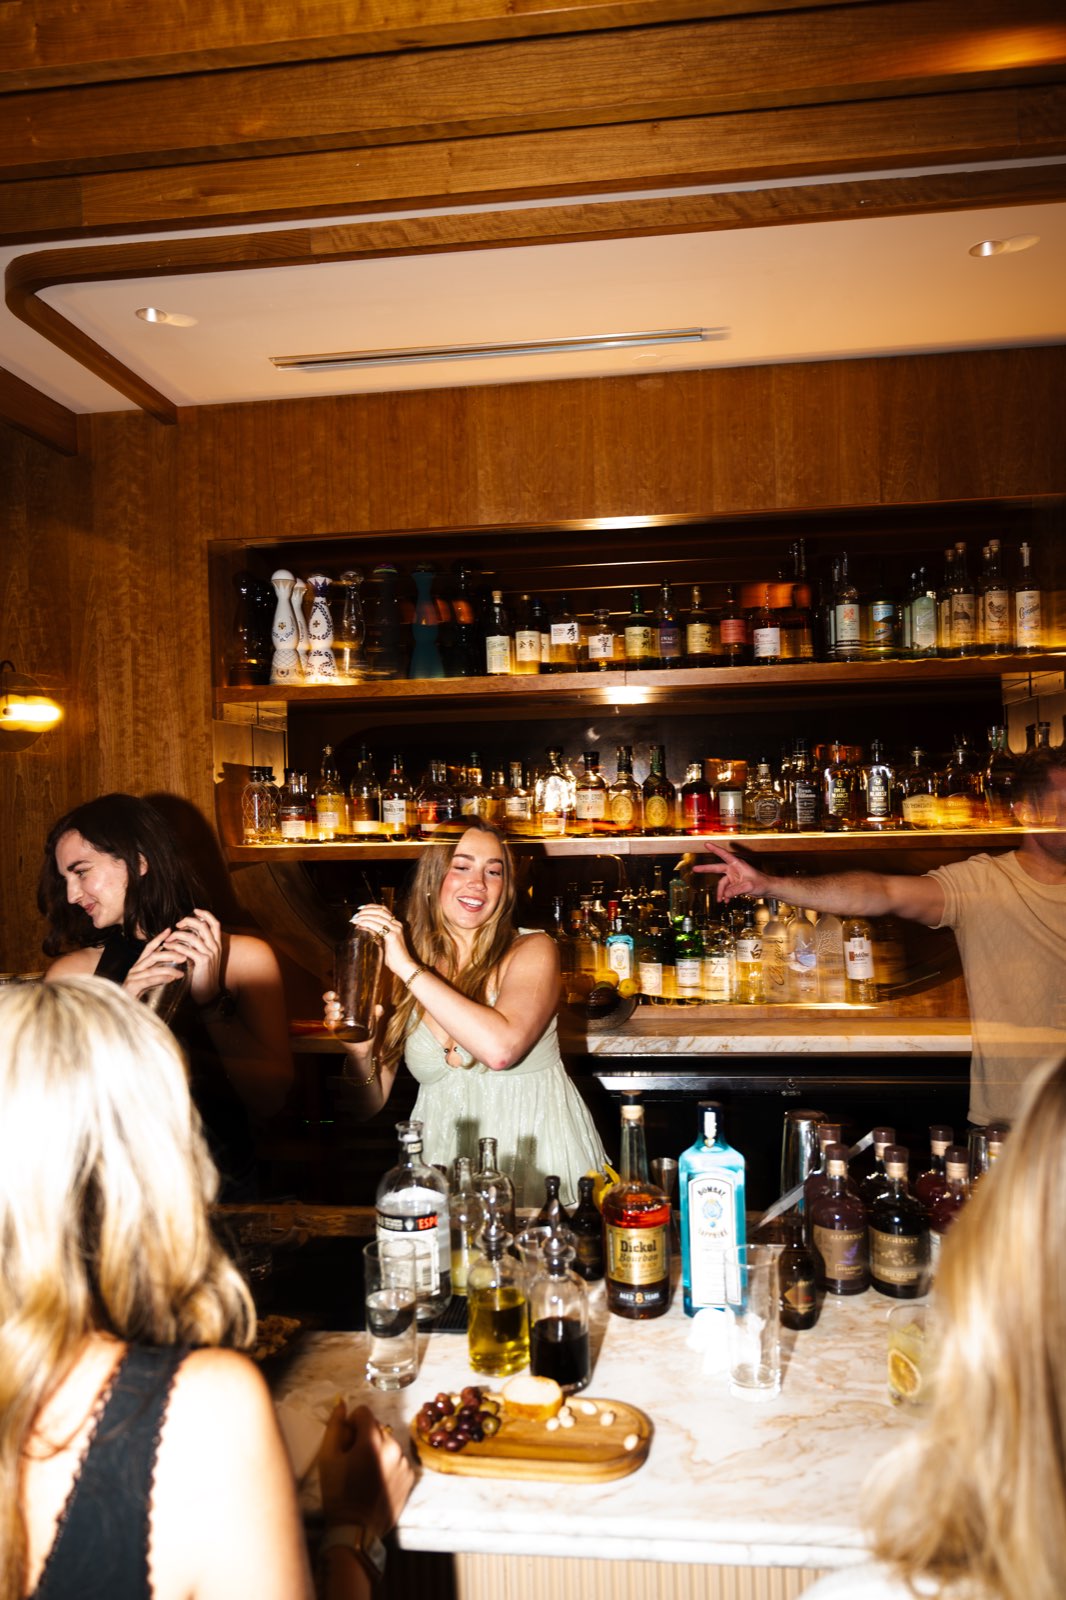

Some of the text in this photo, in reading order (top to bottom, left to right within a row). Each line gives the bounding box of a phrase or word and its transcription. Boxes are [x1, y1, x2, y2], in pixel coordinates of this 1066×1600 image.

[697, 1186, 726, 1197] BOMBAY
[620, 1239, 657, 1253] Dickel
[635, 1292, 644, 1304] 8
